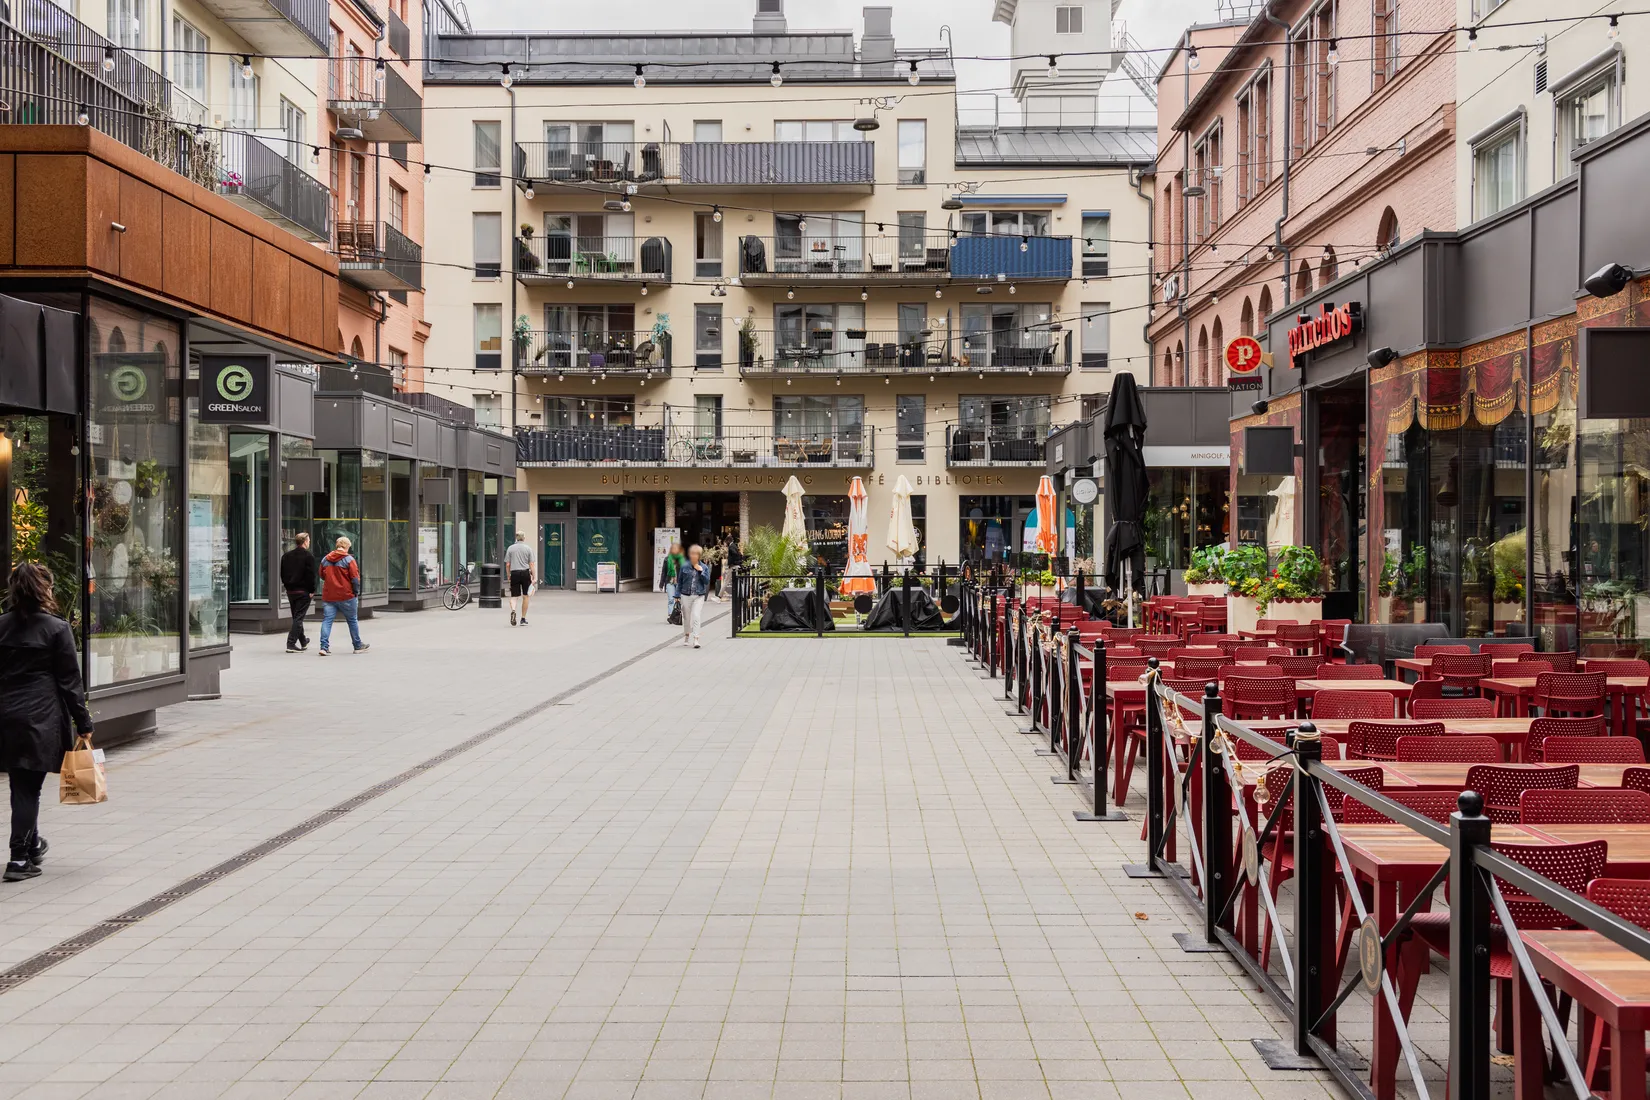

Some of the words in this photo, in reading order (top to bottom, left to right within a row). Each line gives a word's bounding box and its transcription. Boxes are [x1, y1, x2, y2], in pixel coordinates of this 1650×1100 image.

[1287, 301, 1353, 369] pinchos
[1229, 383, 1263, 391] NATION
[1190, 452, 1224, 461] MINIGOLF,
[601, 474, 670, 485] BUTIKER
[845, 473, 885, 485] KFÉ
[917, 475, 1003, 485] BIBLIOTEK
